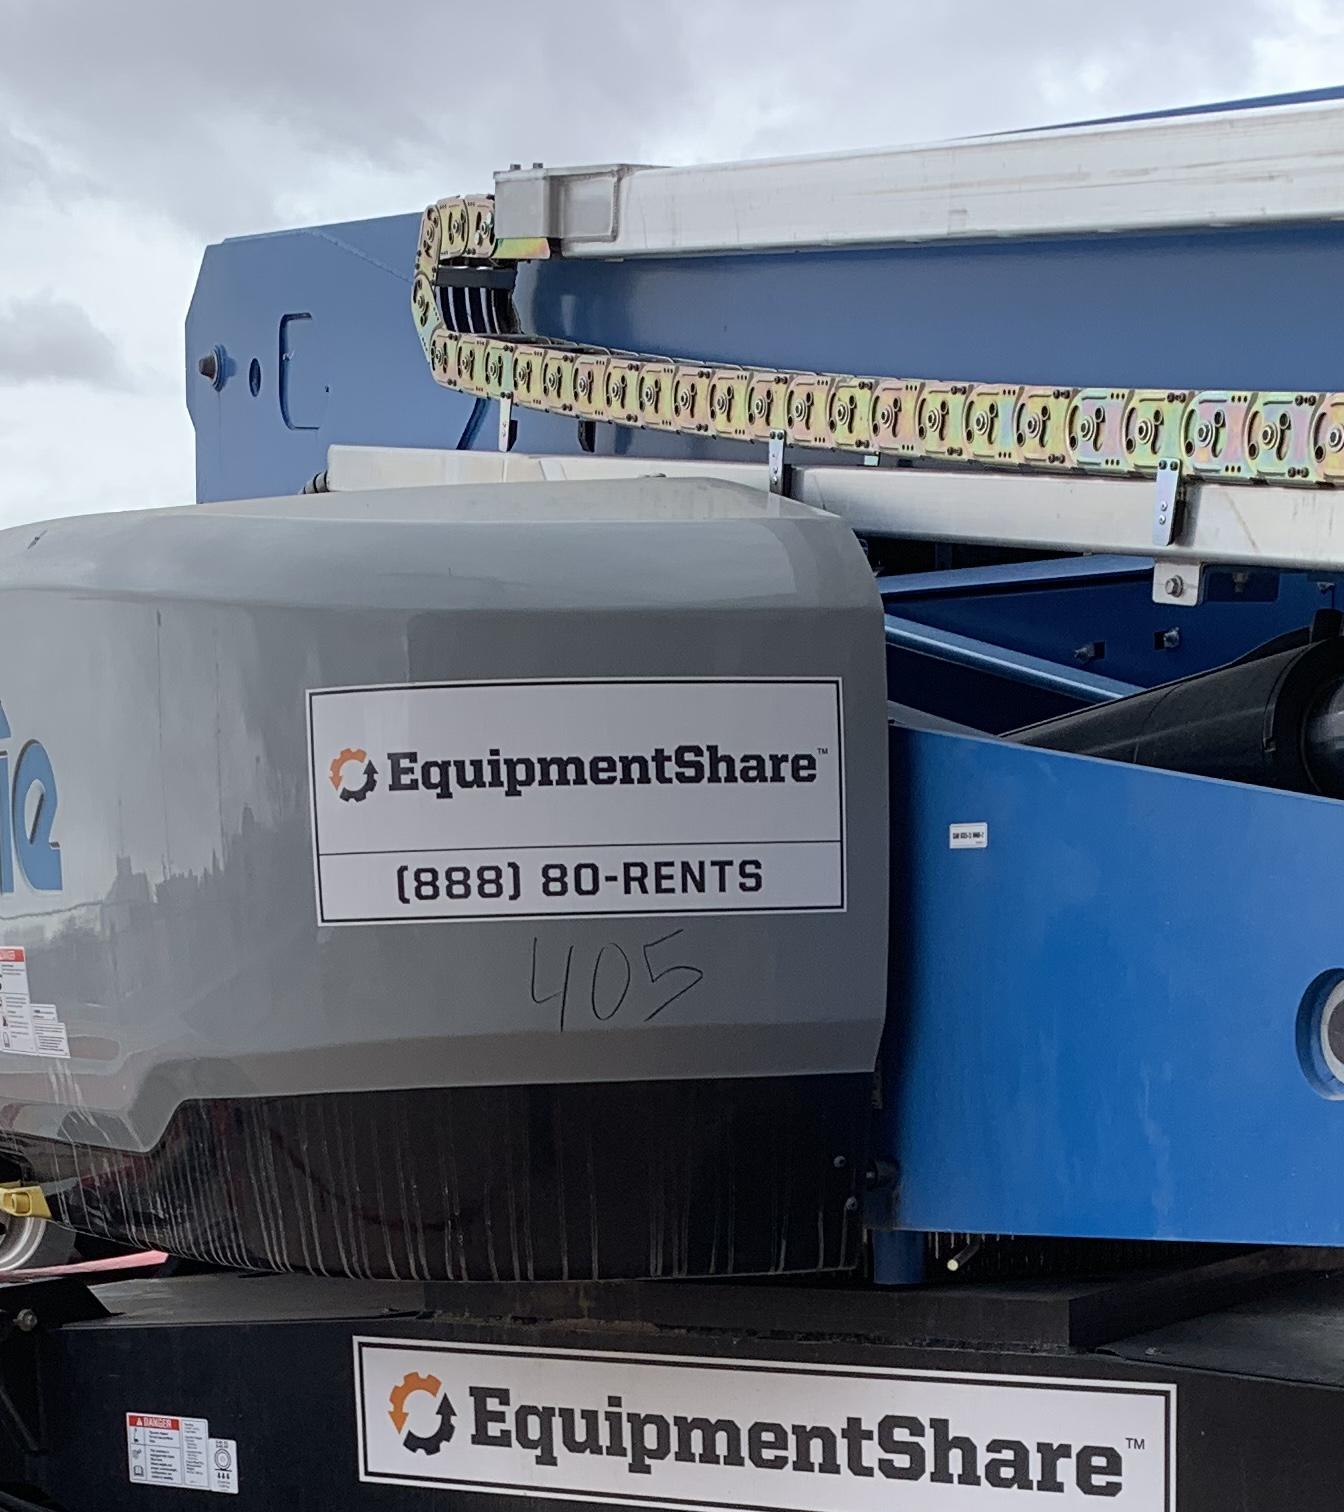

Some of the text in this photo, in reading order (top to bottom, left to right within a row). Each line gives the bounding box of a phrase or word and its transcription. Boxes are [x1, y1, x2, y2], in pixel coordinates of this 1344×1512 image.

[387, 745, 817, 799] EquipmentShare
[396, 859, 763, 904] (888) 80-RENTS
[531, 929, 703, 1032] 405
[468, 1385, 1123, 1497] EquipmentShare
